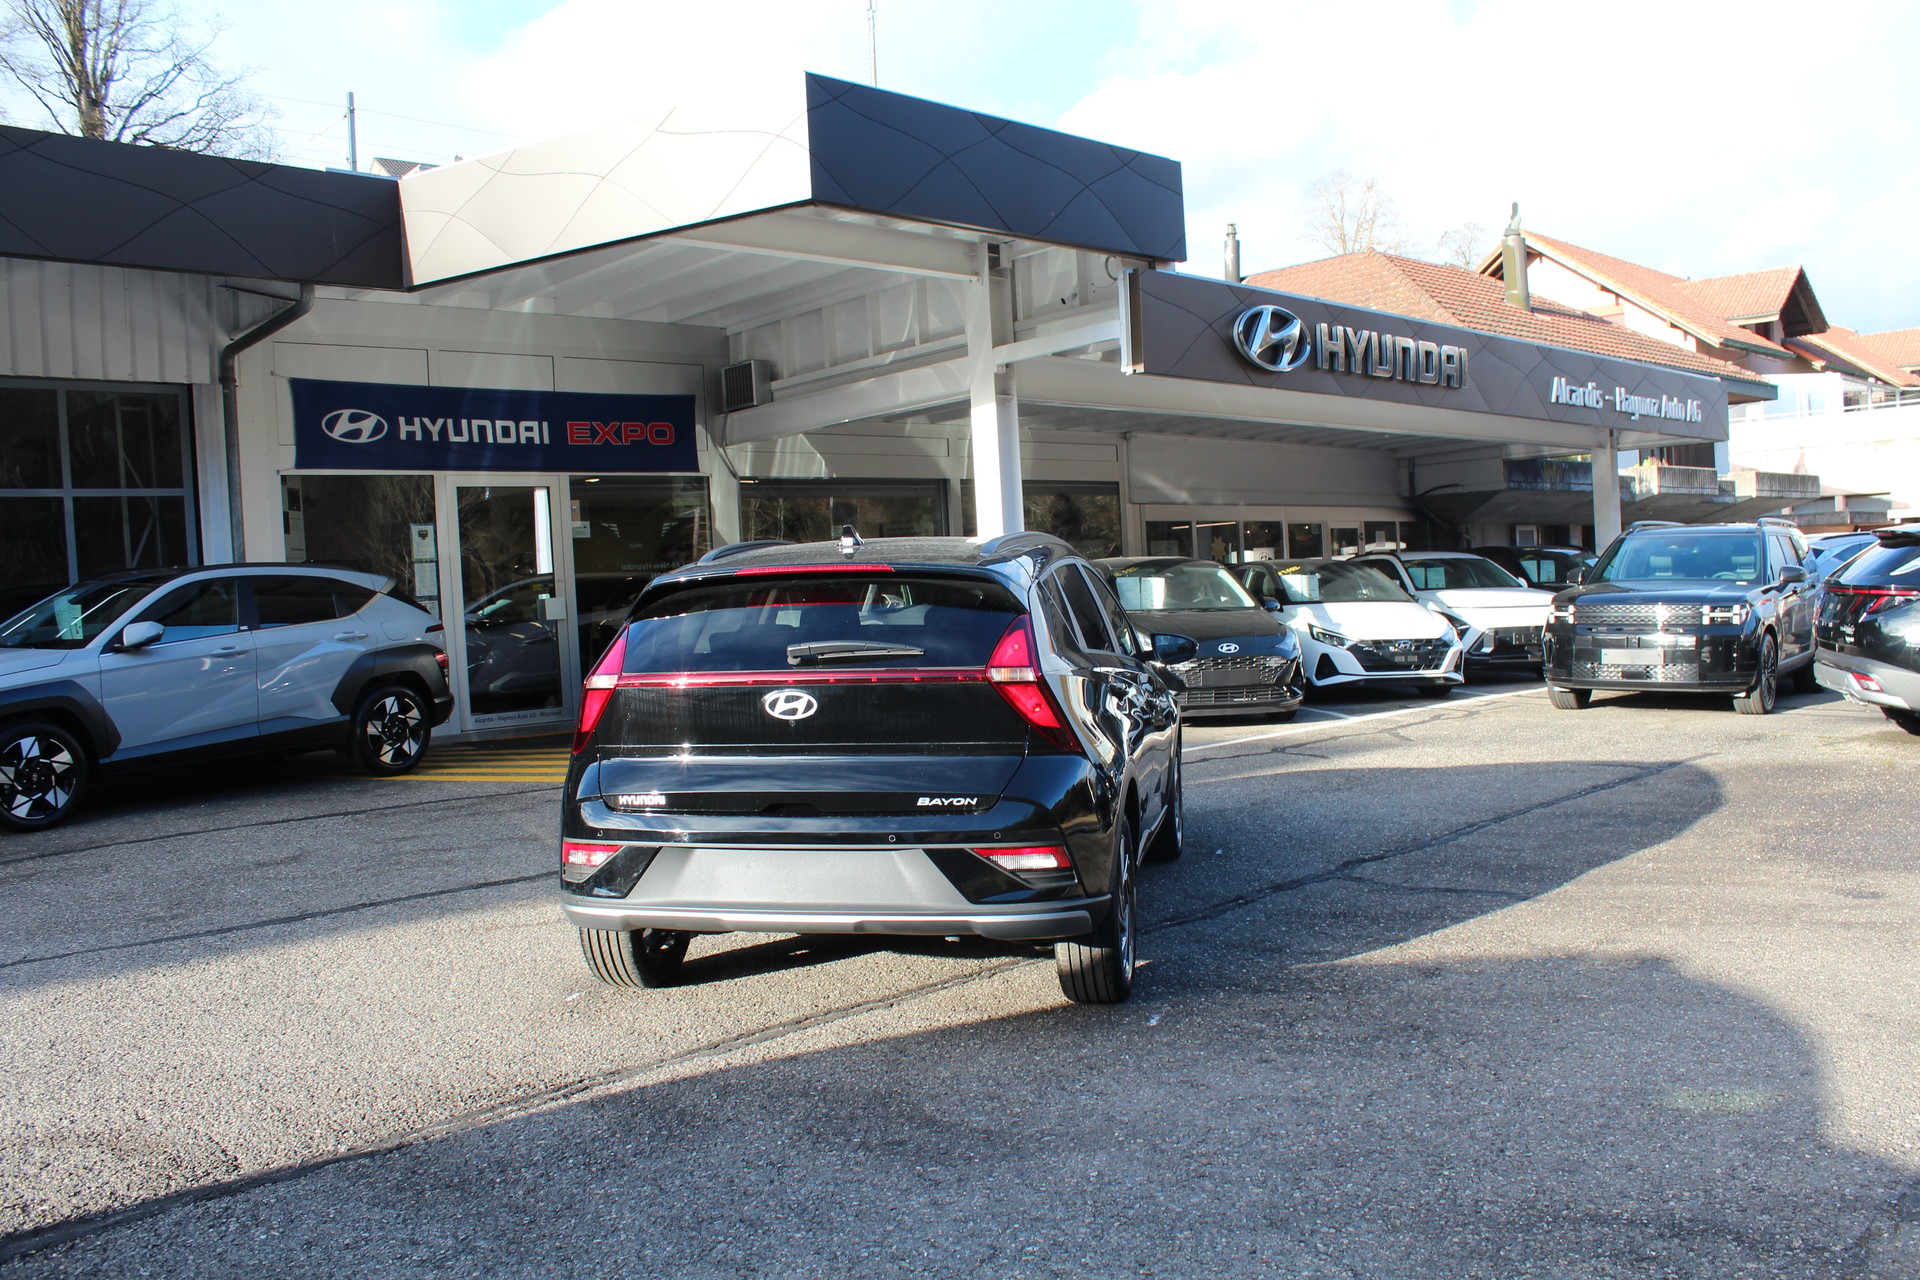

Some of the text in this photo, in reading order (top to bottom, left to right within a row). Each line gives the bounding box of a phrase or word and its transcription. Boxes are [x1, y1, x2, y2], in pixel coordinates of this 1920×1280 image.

[1315, 322, 1469, 389] HYUNDAI
[1550, 376, 1603, 409] Alcardis
[1615, 386, 1661, 421] Haymoz
[1660, 394, 1686, 421] Auto
[1685, 399, 1702, 423] AG
[398, 416, 675, 446] HYUNDAI EXPO
[618, 794, 666, 806] HYUNDAI
[916, 797, 978, 806] BAYON
